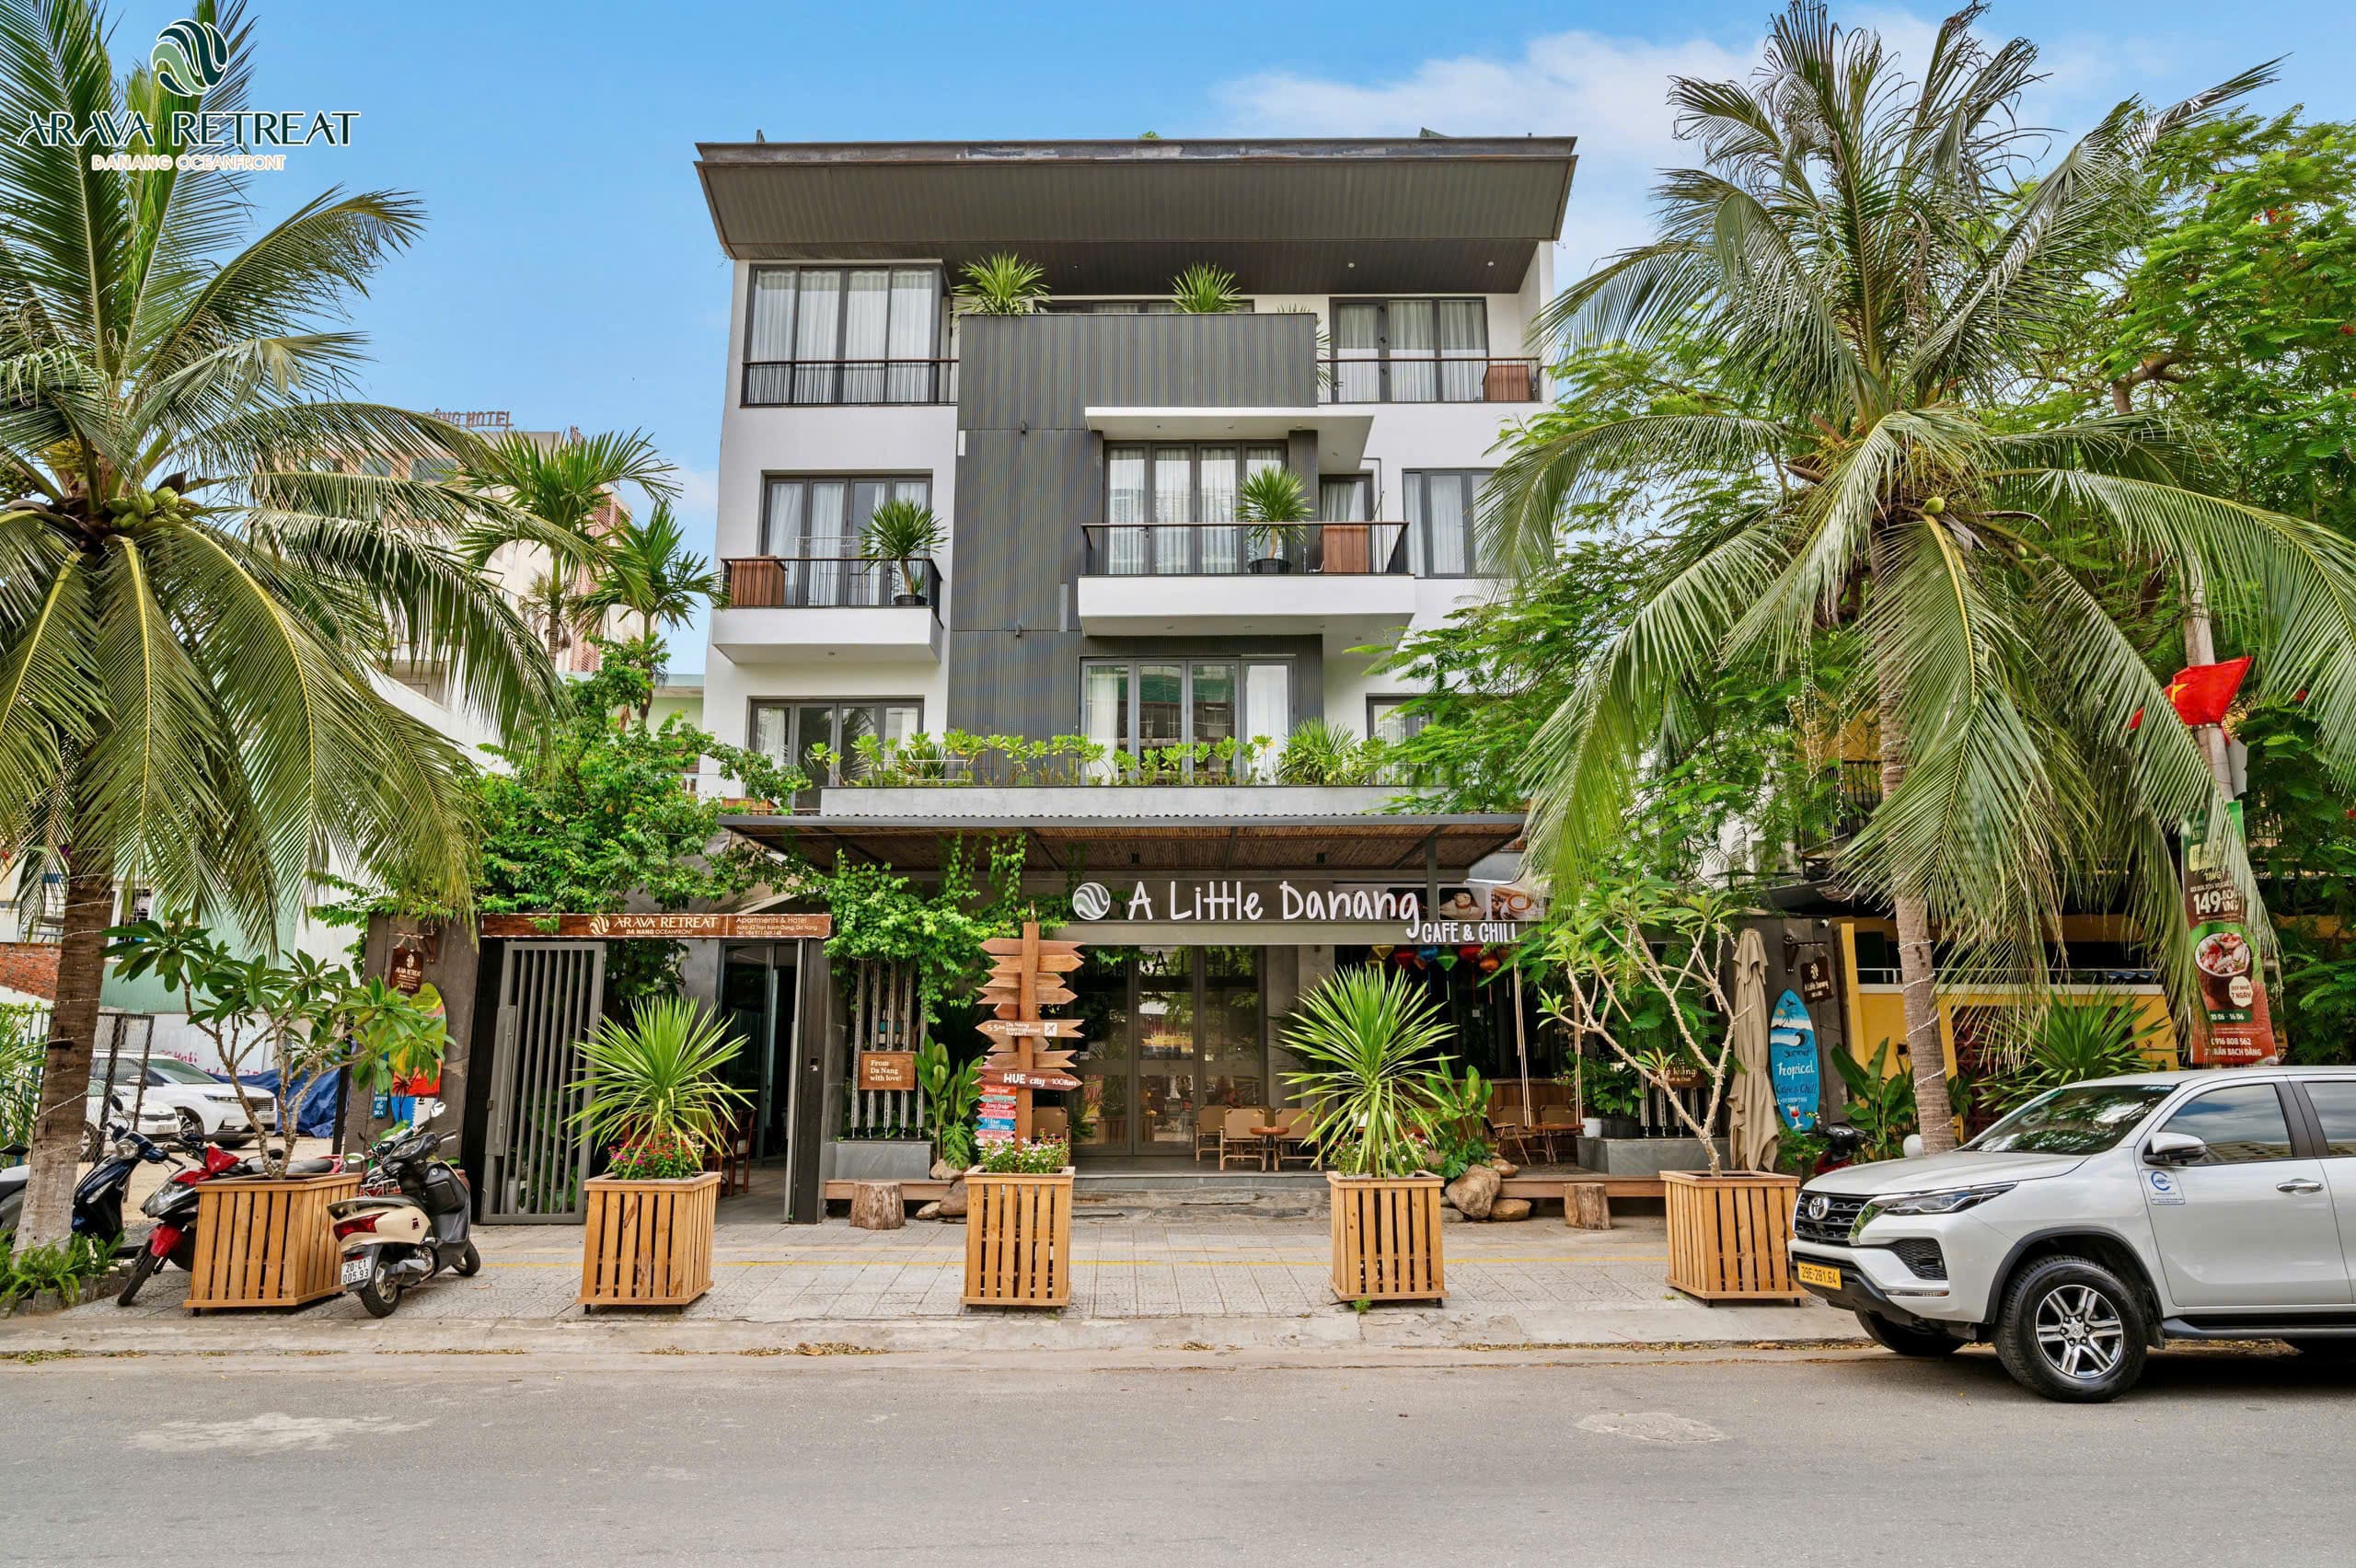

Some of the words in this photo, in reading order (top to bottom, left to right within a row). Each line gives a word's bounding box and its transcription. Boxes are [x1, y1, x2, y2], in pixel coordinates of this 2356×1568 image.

[465, 411, 514, 427] HOTEL
[1127, 880, 1153, 920] A
[1170, 880, 1264, 921] Little
[1279, 880, 1420, 939] Danang
[614, 917, 656, 928] ARAVA
[660, 917, 719, 928] RETREAT
[736, 917, 779, 925] Apartments
[1422, 922, 1460, 943] CAFE
[1462, 924, 1474, 941] &
[1478, 922, 1519, 943] CHILL
[1776, 1060, 1816, 1080] Tropical
[1003, 1073, 1026, 1084] HUE
[1029, 1077, 1045, 1088] city
